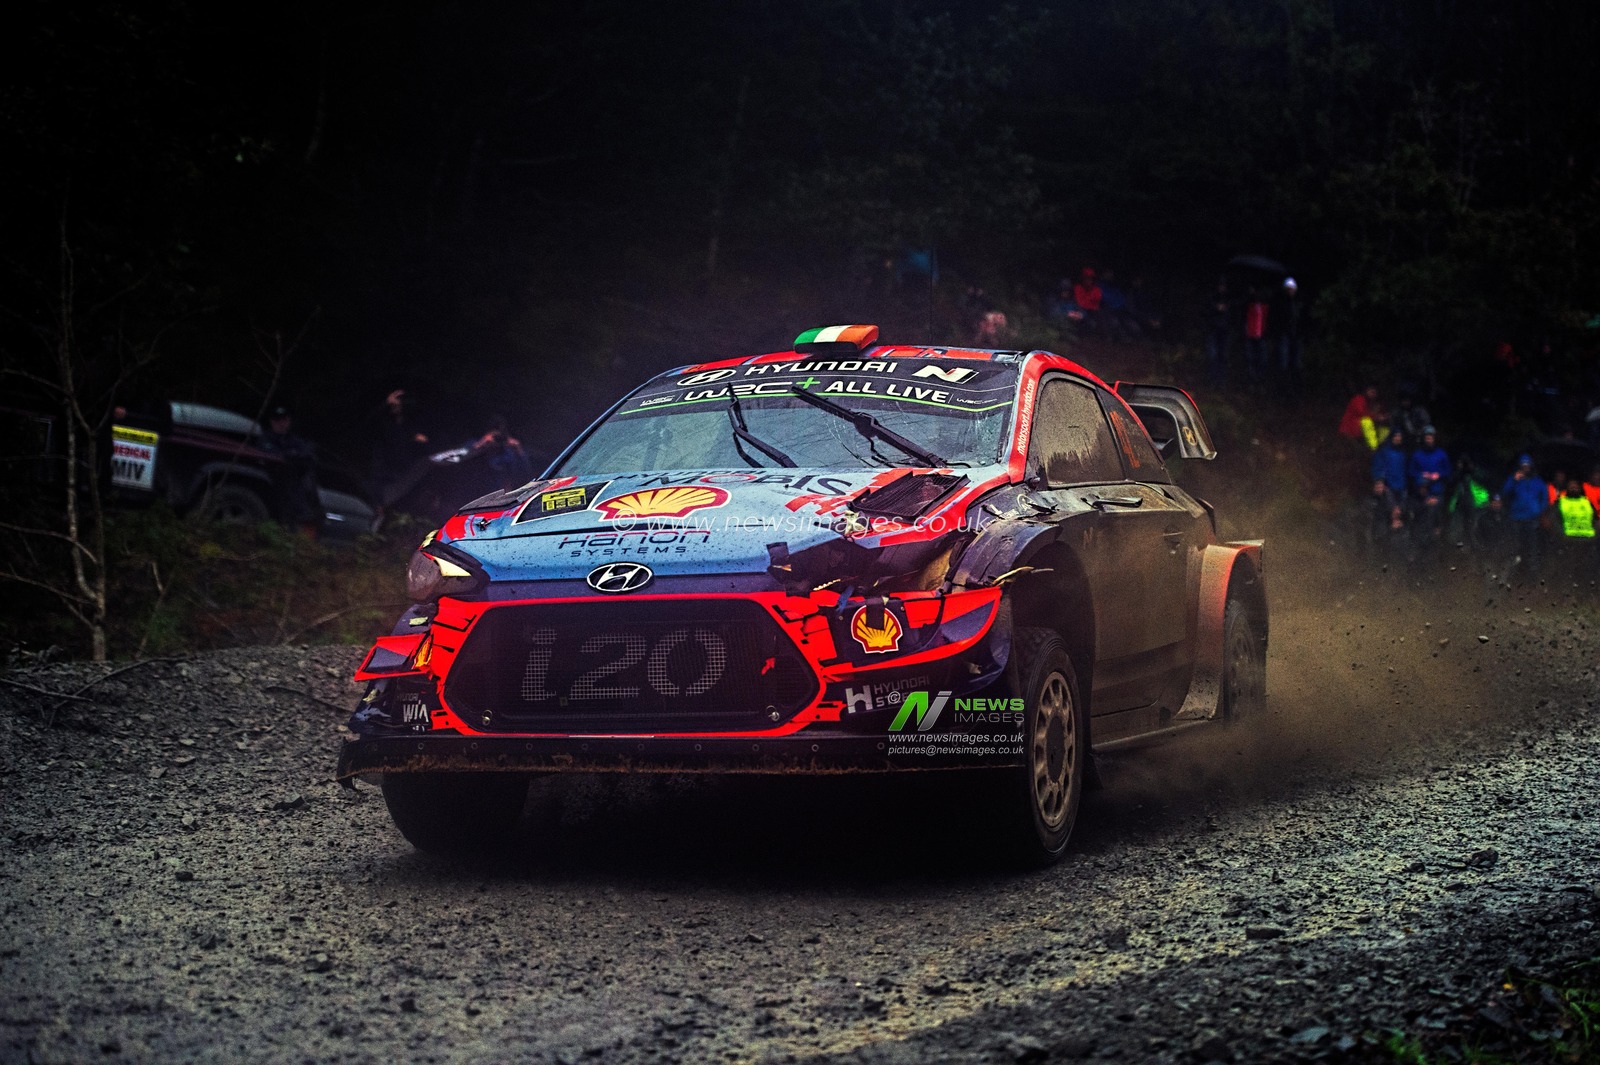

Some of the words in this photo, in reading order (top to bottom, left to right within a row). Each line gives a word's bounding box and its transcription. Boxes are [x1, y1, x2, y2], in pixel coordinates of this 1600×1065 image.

[744, 361, 898, 377] HYUNDAI
[825, 381, 883, 394] ALL
[886, 384, 950, 403] LIVE
[1017, 378, 1036, 456] motorsport.hyundai.com
[637, 474, 853, 497] MOBIS
[570, 546, 687, 558] SYSTEMS
[873, 676, 930, 695] HYUNDAI
